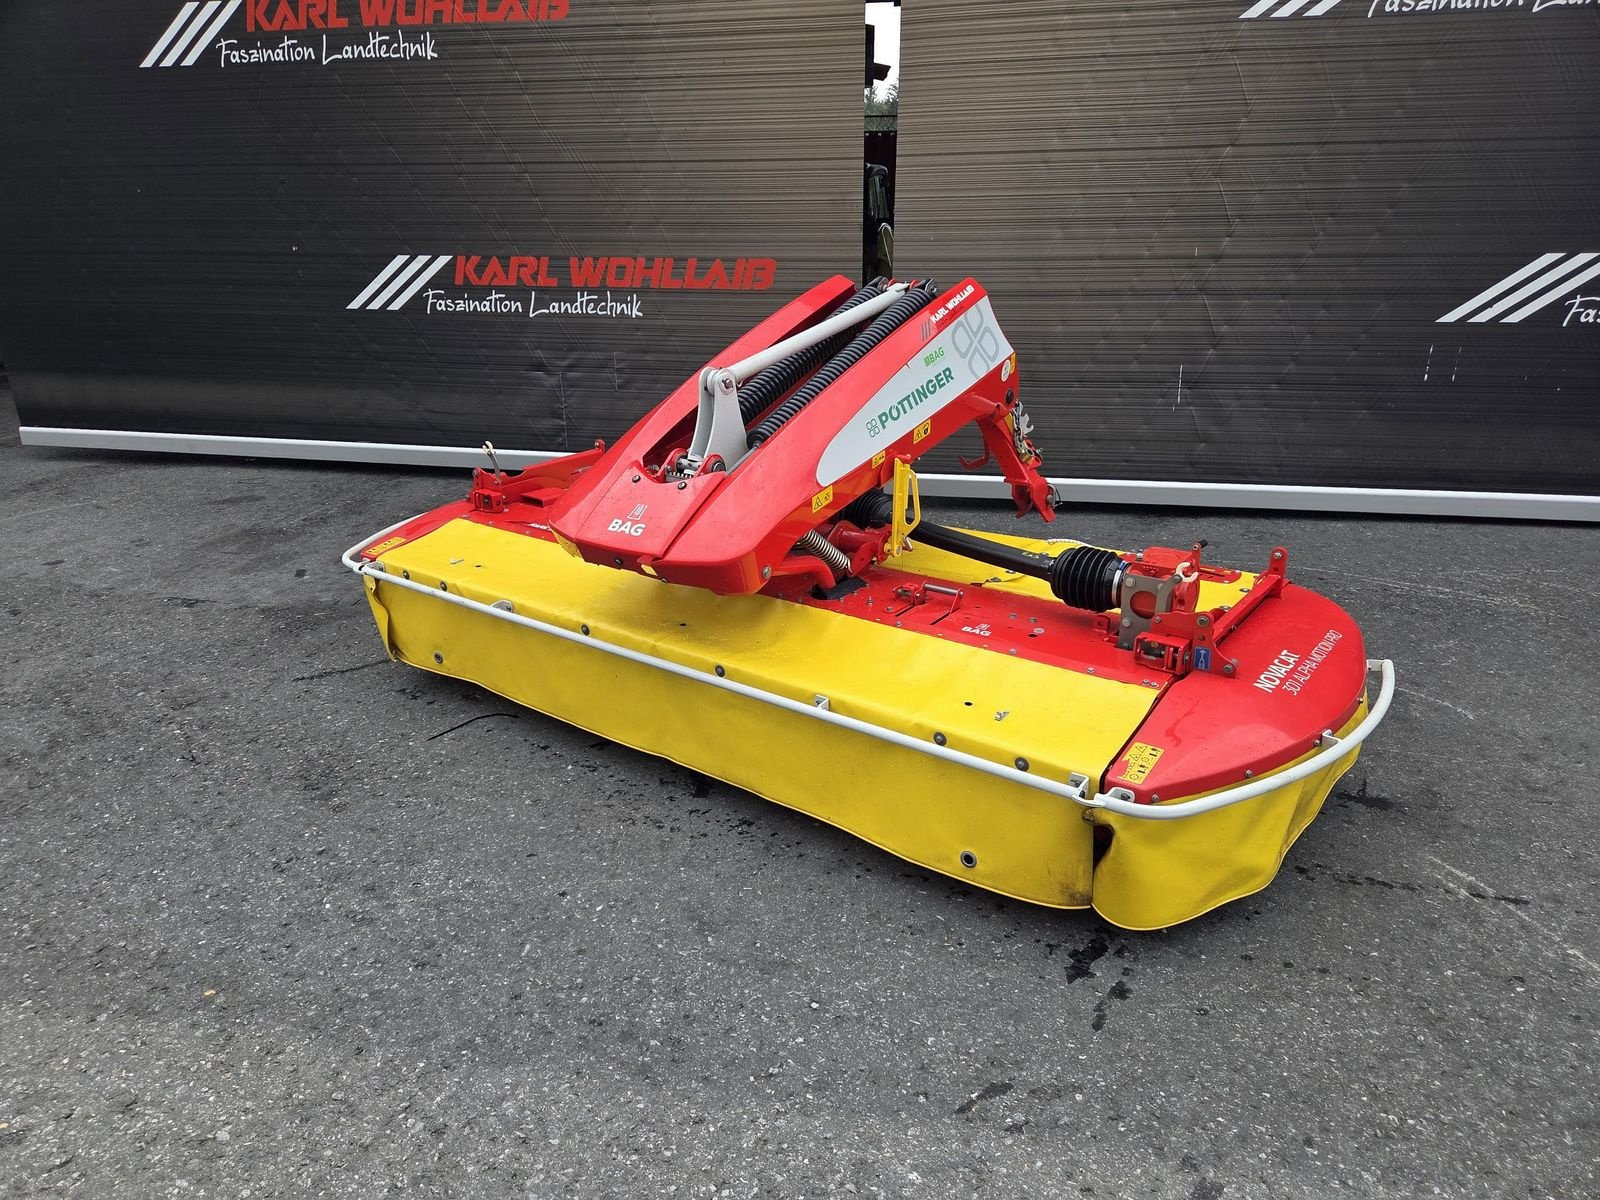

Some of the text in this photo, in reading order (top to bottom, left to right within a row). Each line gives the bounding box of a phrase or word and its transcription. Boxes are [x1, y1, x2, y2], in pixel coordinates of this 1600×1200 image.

[246, 0, 348, 32] KARL
[216, 30, 438, 67] Faszination Landtechnik
[454, 255, 558, 287] KARL
[423, 288, 643, 318] Faszination Landtechnik
[930, 307, 949, 323] KARL
[928, 346, 945, 364] BAG
[877, 367, 954, 430] PÖTTINGER
[607, 518, 646, 537] BAG
[960, 626, 992, 637] BAG
[1253, 649, 1300, 693] NOVACAT
[1282, 629, 1343, 696] 301 ALPHA MOTION PRO
